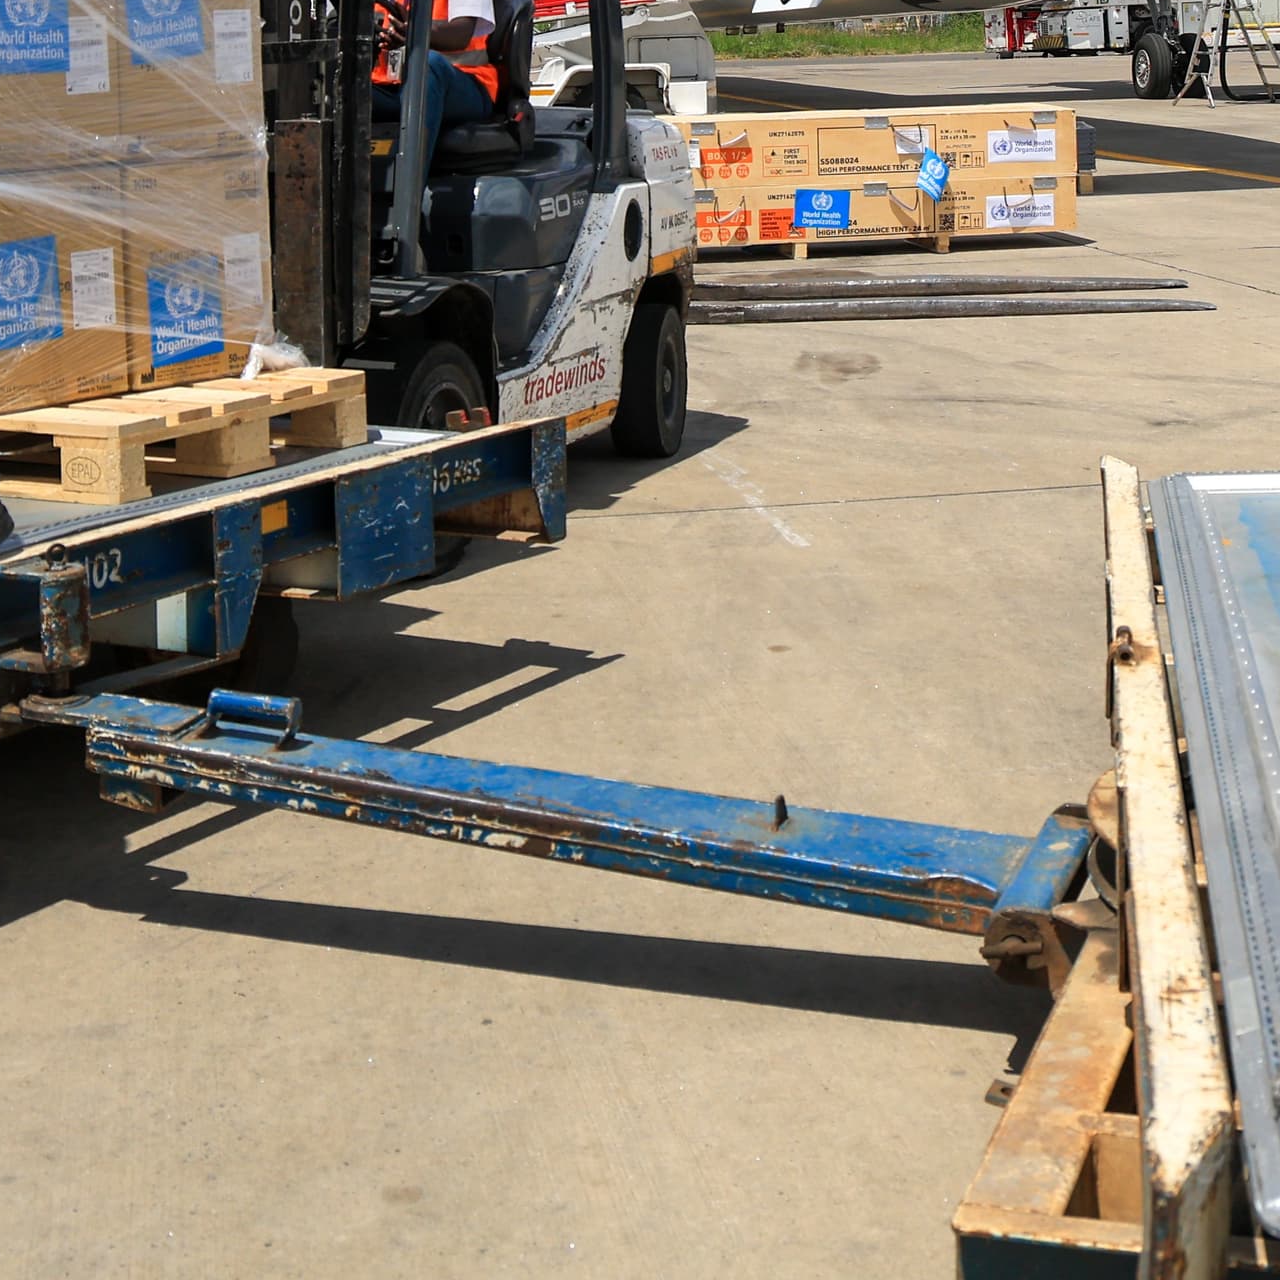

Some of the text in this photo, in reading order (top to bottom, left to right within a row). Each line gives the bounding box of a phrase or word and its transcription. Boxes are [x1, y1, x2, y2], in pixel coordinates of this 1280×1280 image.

[132, 15, 198, 38] World Health
[29, 30, 64, 44] Health
[1034, 139, 1053, 147] Health
[1014, 146, 1053, 154] Organization
[707, 152, 747, 161] BOX 1/2
[838, 165, 891, 173] PERFORMANCE
[539, 193, 571, 221] 30
[1012, 205, 1031, 213] World
[802, 211, 841, 219] World Health
[1012, 211, 1051, 219] Organization
[838, 227, 889, 235] PERFORMANCE
[155, 314, 219, 340] World Health
[524, 357, 606, 406] tradewinds
[71, 463, 96, 480] EPAL
